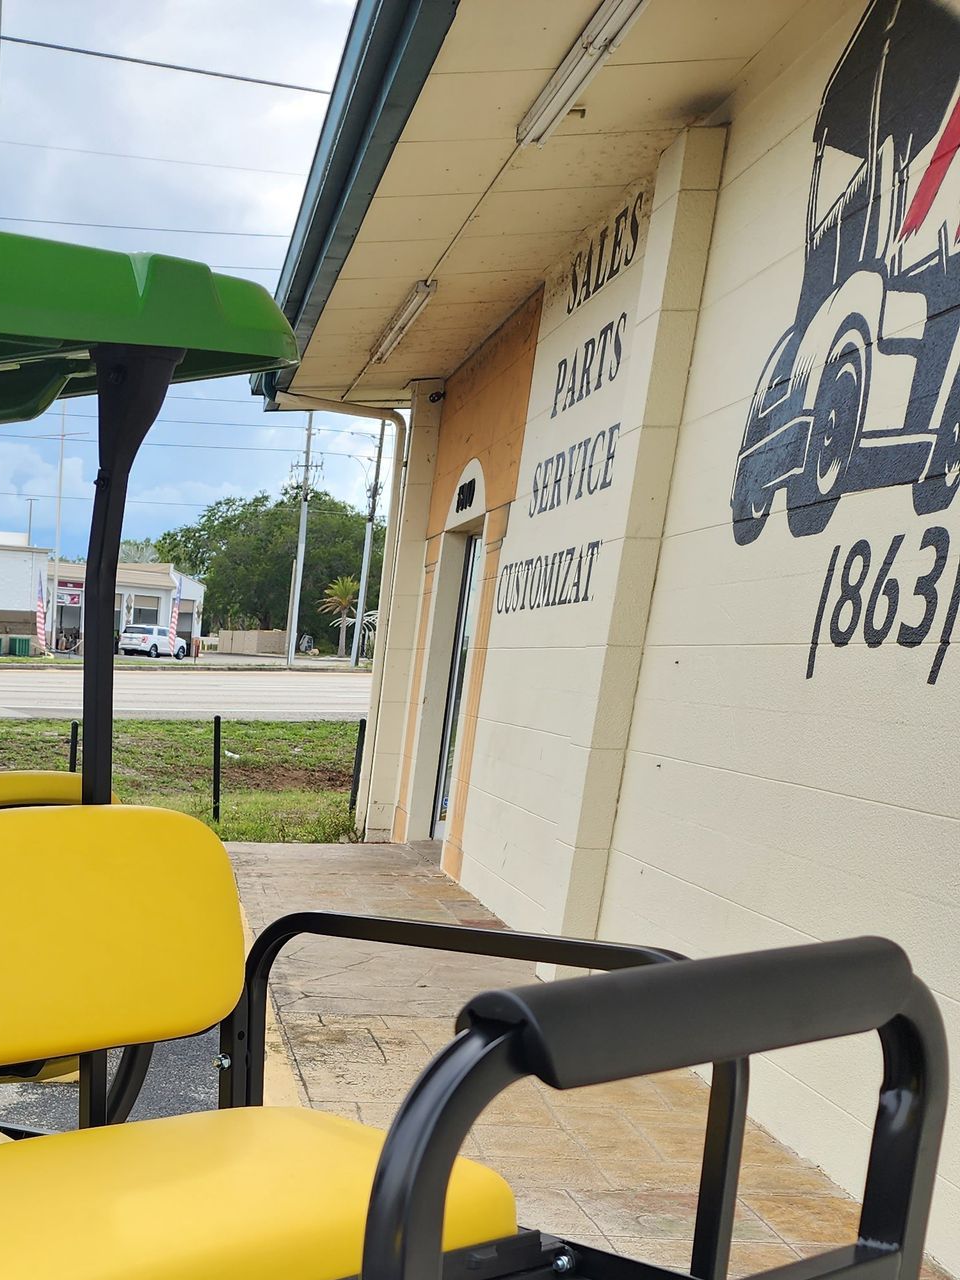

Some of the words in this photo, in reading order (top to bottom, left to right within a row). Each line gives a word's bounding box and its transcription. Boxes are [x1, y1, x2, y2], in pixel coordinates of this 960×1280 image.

[566, 191, 645, 315] SALES
[550, 311, 628, 419] PARTS
[528, 422, 621, 519] SERVICE
[496, 539, 603, 615] CUSTOMIZAT
